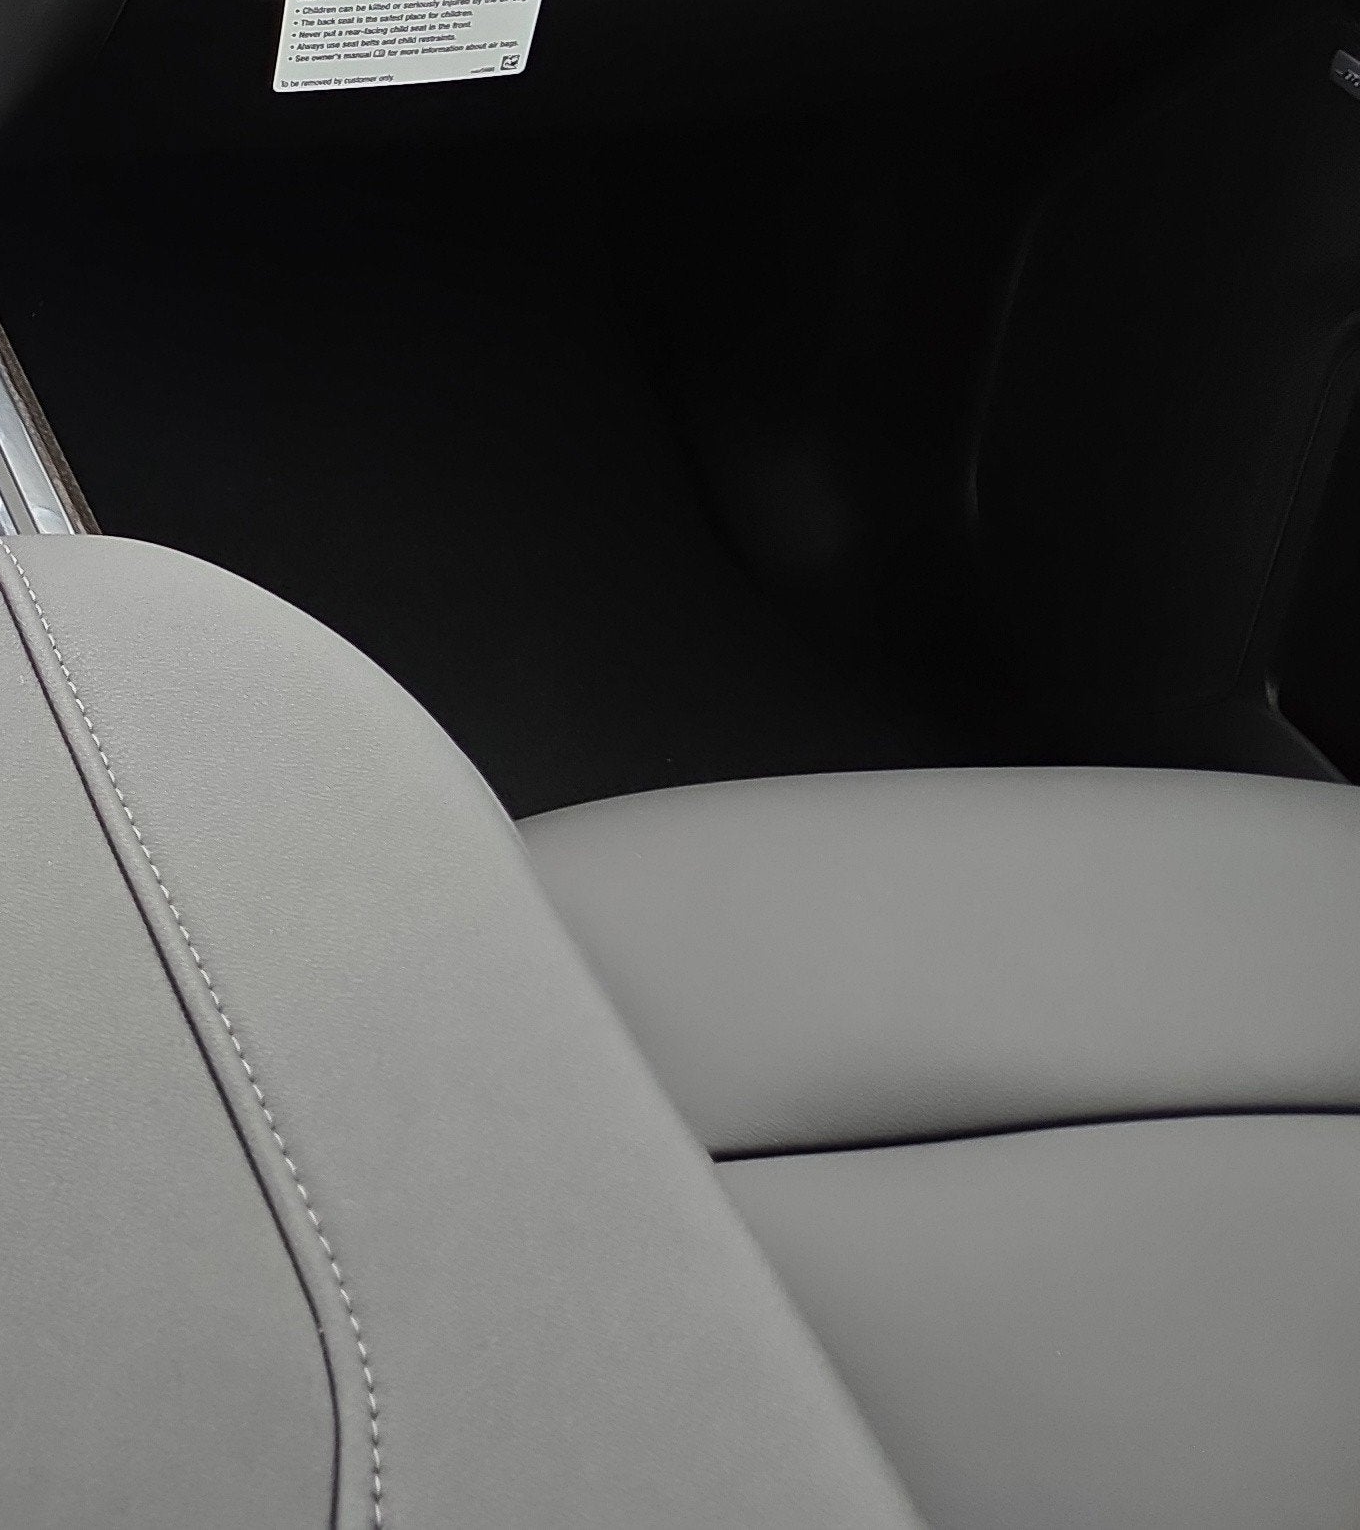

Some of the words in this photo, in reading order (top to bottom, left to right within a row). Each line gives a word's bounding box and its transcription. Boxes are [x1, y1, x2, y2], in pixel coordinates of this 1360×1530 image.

[302, 6, 337, 15] Children
[403, 1, 440, 10] seriously
[390, 25, 409, 33] child
[398, 36, 417, 44] child
[301, 78, 332, 86] removed
[333, 77, 342, 85] by
[344, 76, 377, 84] customer
